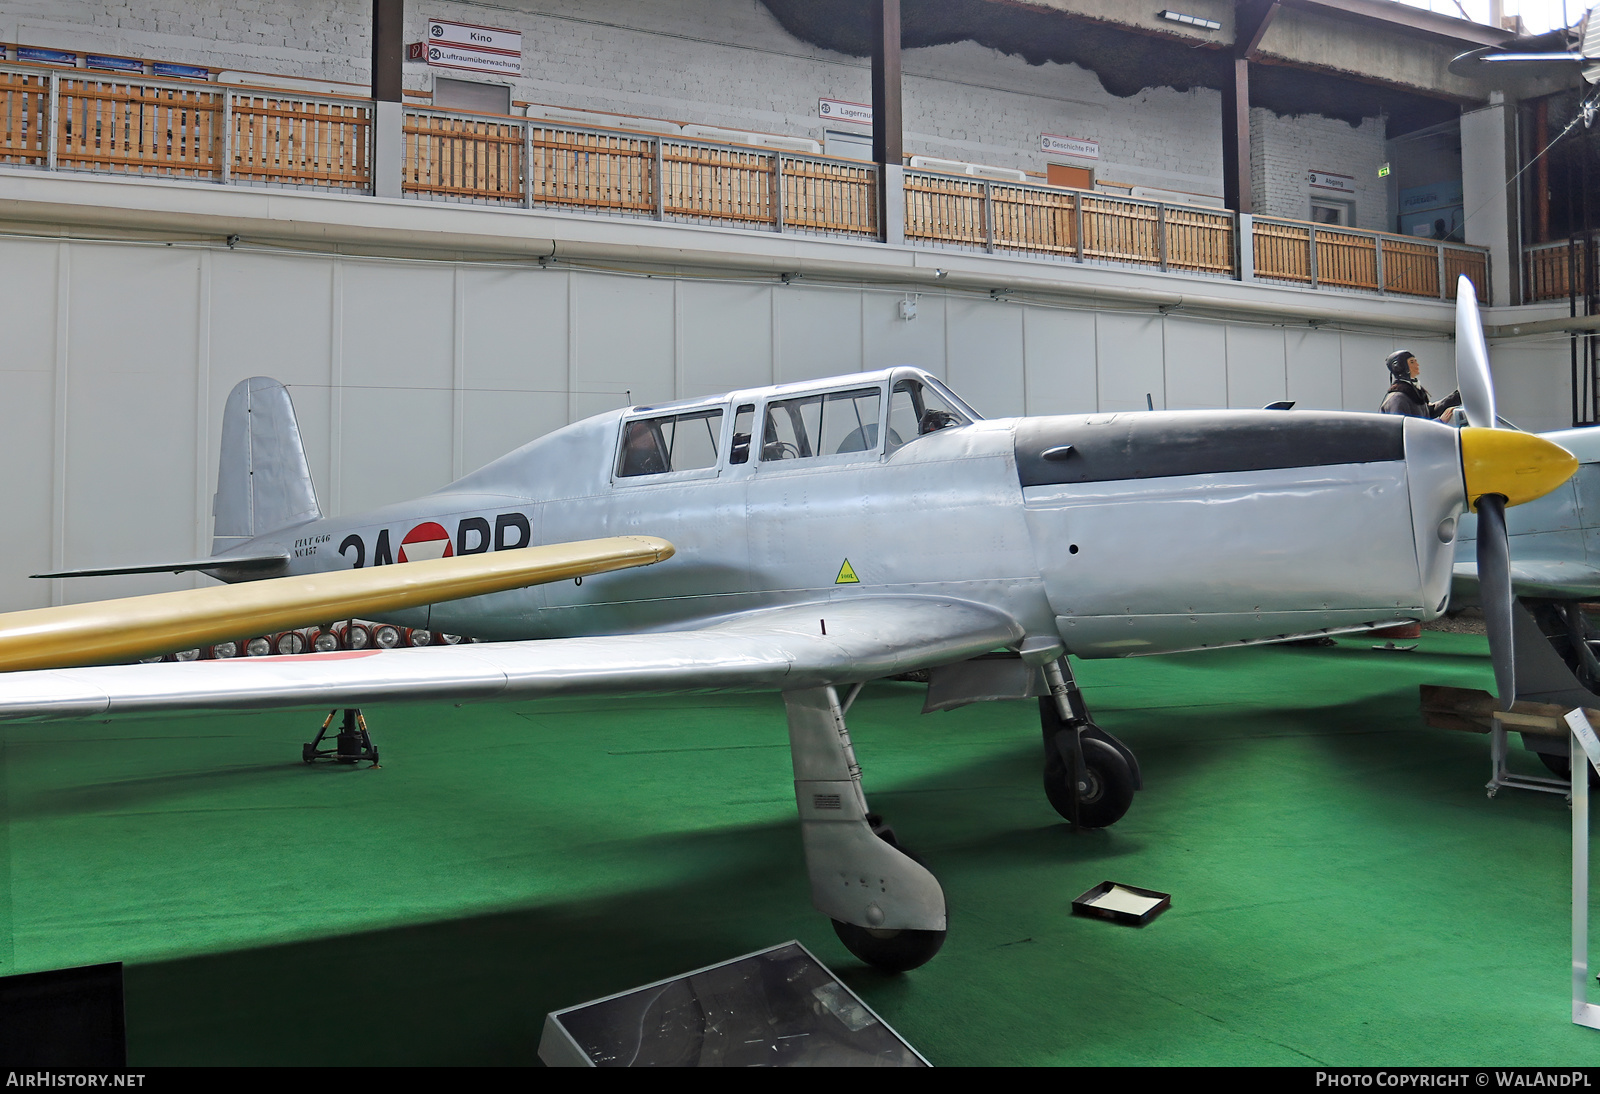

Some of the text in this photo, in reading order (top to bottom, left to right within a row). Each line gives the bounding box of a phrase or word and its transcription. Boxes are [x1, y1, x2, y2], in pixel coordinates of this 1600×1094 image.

[432, 27, 492, 43] 23 Kino
[430, 50, 521, 70] 24 Luftraumüberwachung
[840, 107, 872, 118] Lagerrau
[1052, 141, 1084, 151] Geschichte
[1325, 178, 1344, 187] Abgang
[295, 534, 331, 548] FIAT G46
